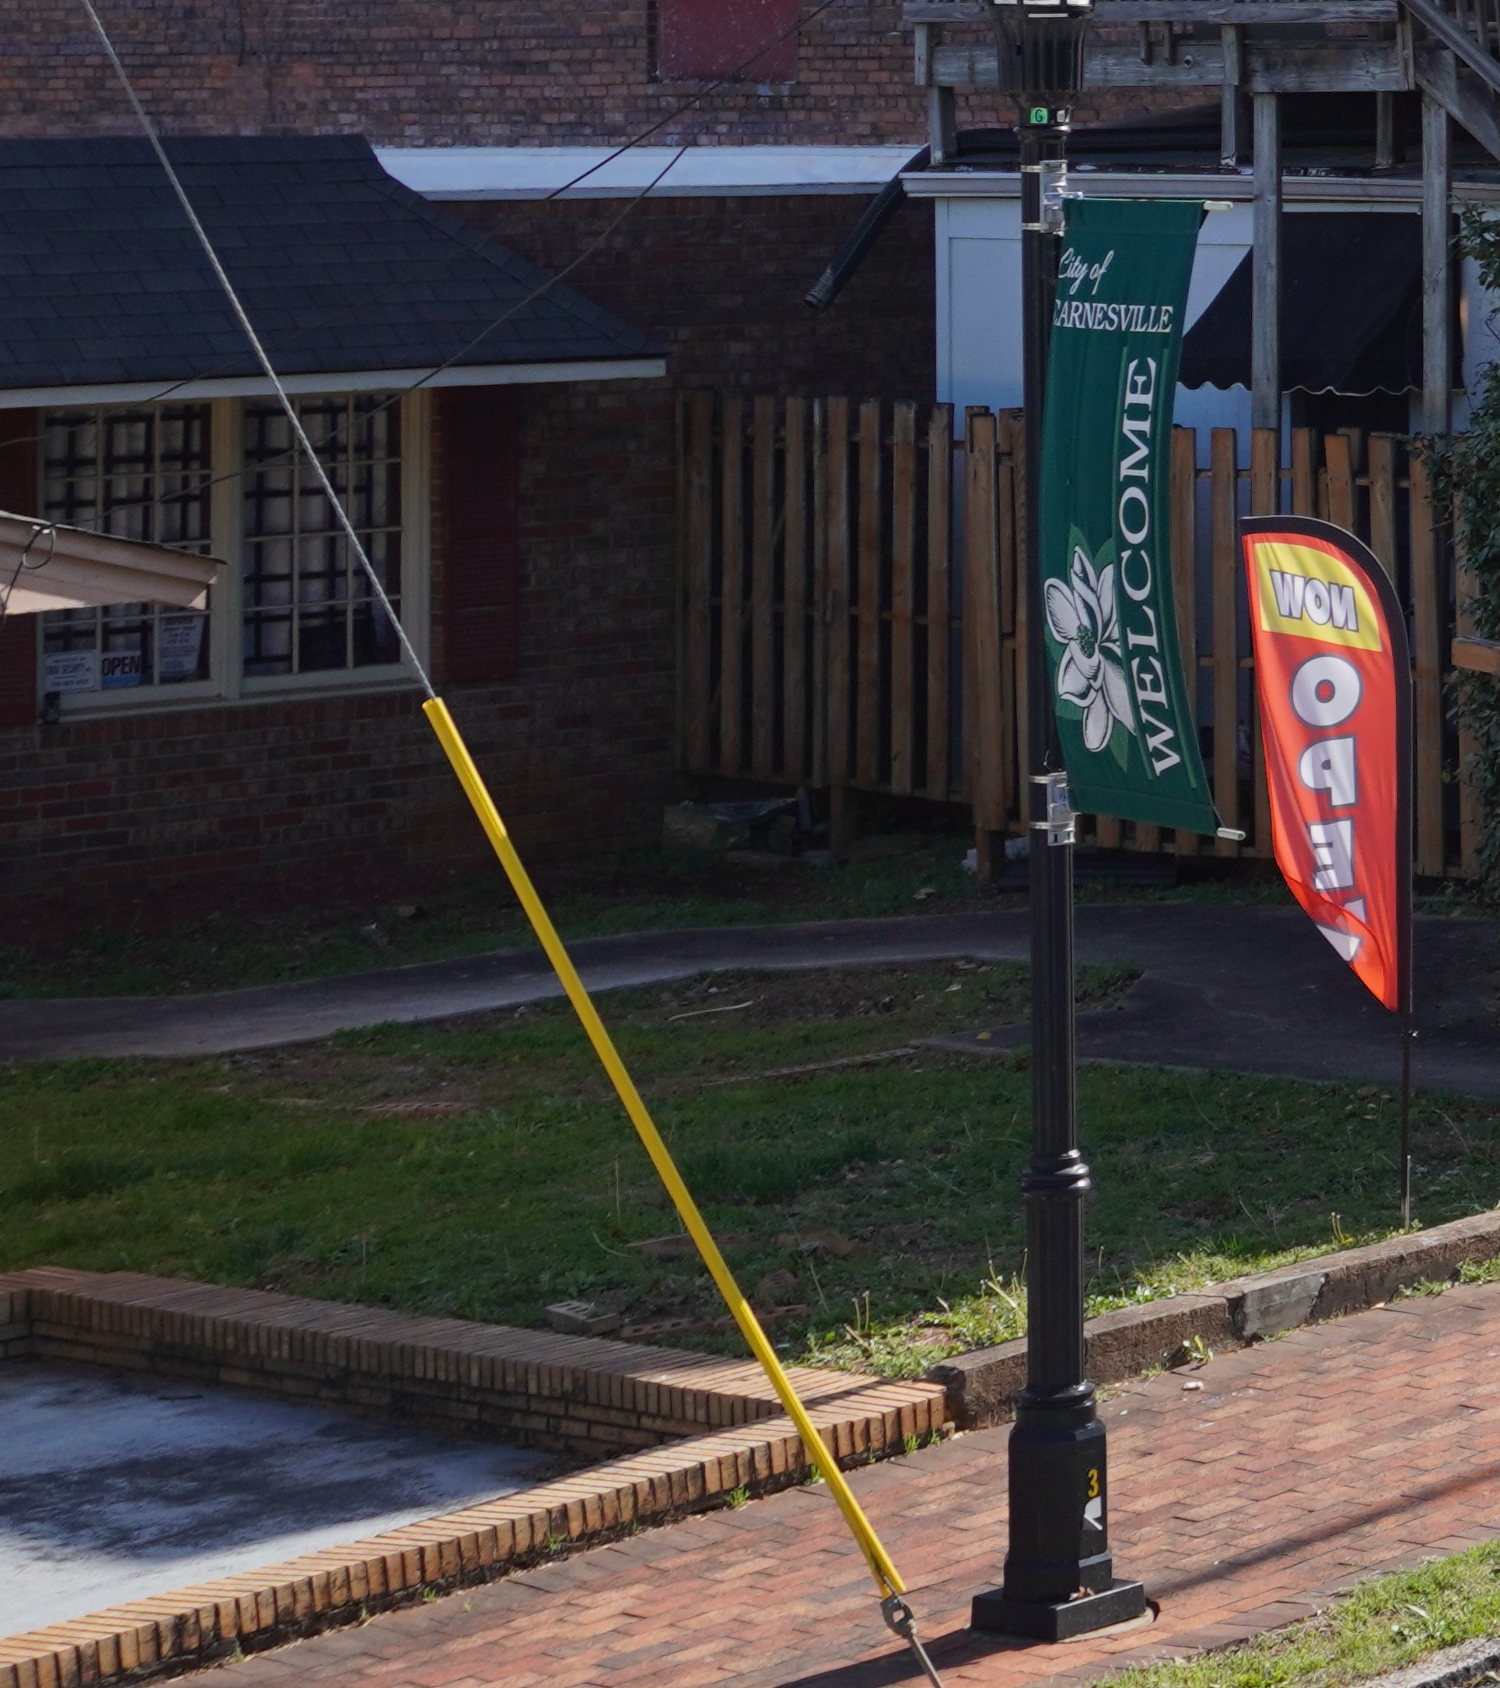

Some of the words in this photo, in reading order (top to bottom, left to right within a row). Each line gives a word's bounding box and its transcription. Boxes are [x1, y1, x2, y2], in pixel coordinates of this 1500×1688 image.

[1058, 247, 1088, 296] City
[1089, 250, 1114, 296] of
[1119, 357, 1181, 776] WELCOME
[102, 655, 140, 677] OPEN
[1087, 1468, 1099, 1498] 3
